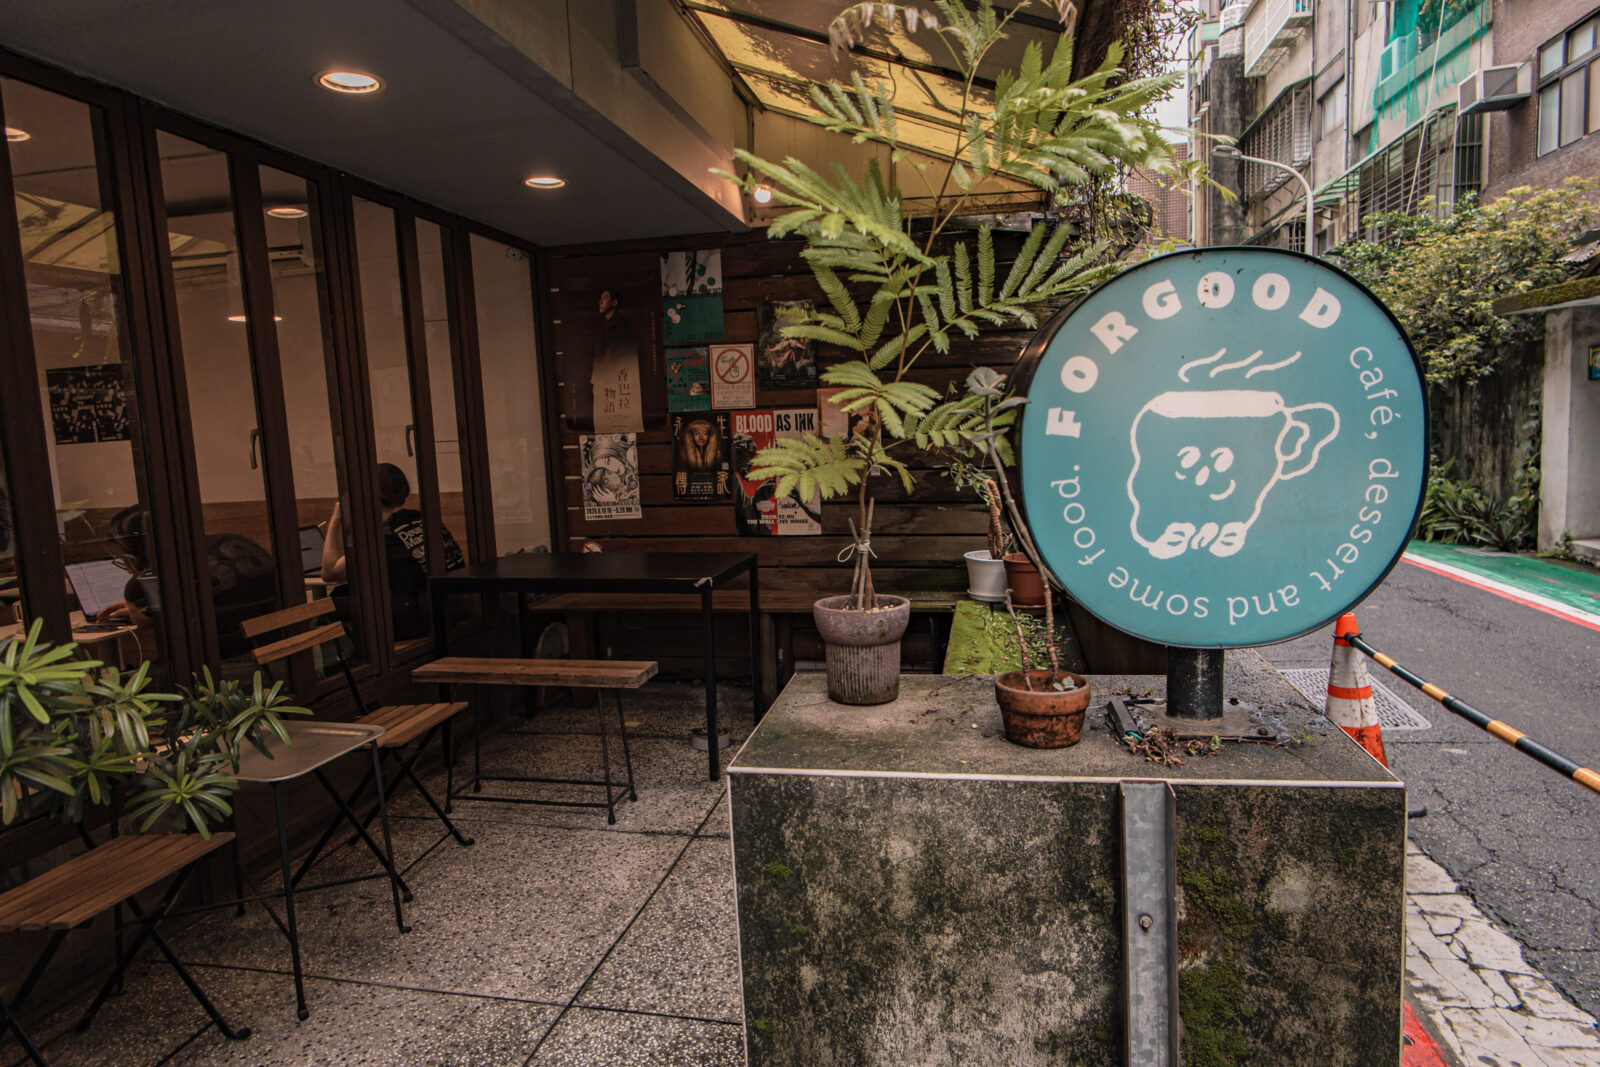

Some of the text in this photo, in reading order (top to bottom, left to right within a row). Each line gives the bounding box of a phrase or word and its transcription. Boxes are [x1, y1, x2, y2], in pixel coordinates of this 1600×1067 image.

[735, 412, 815, 433] BLOOD AS INK
[1045, 271, 1342, 438] FORGOOD
[1050, 346, 1401, 625] café, dessert and some food.
